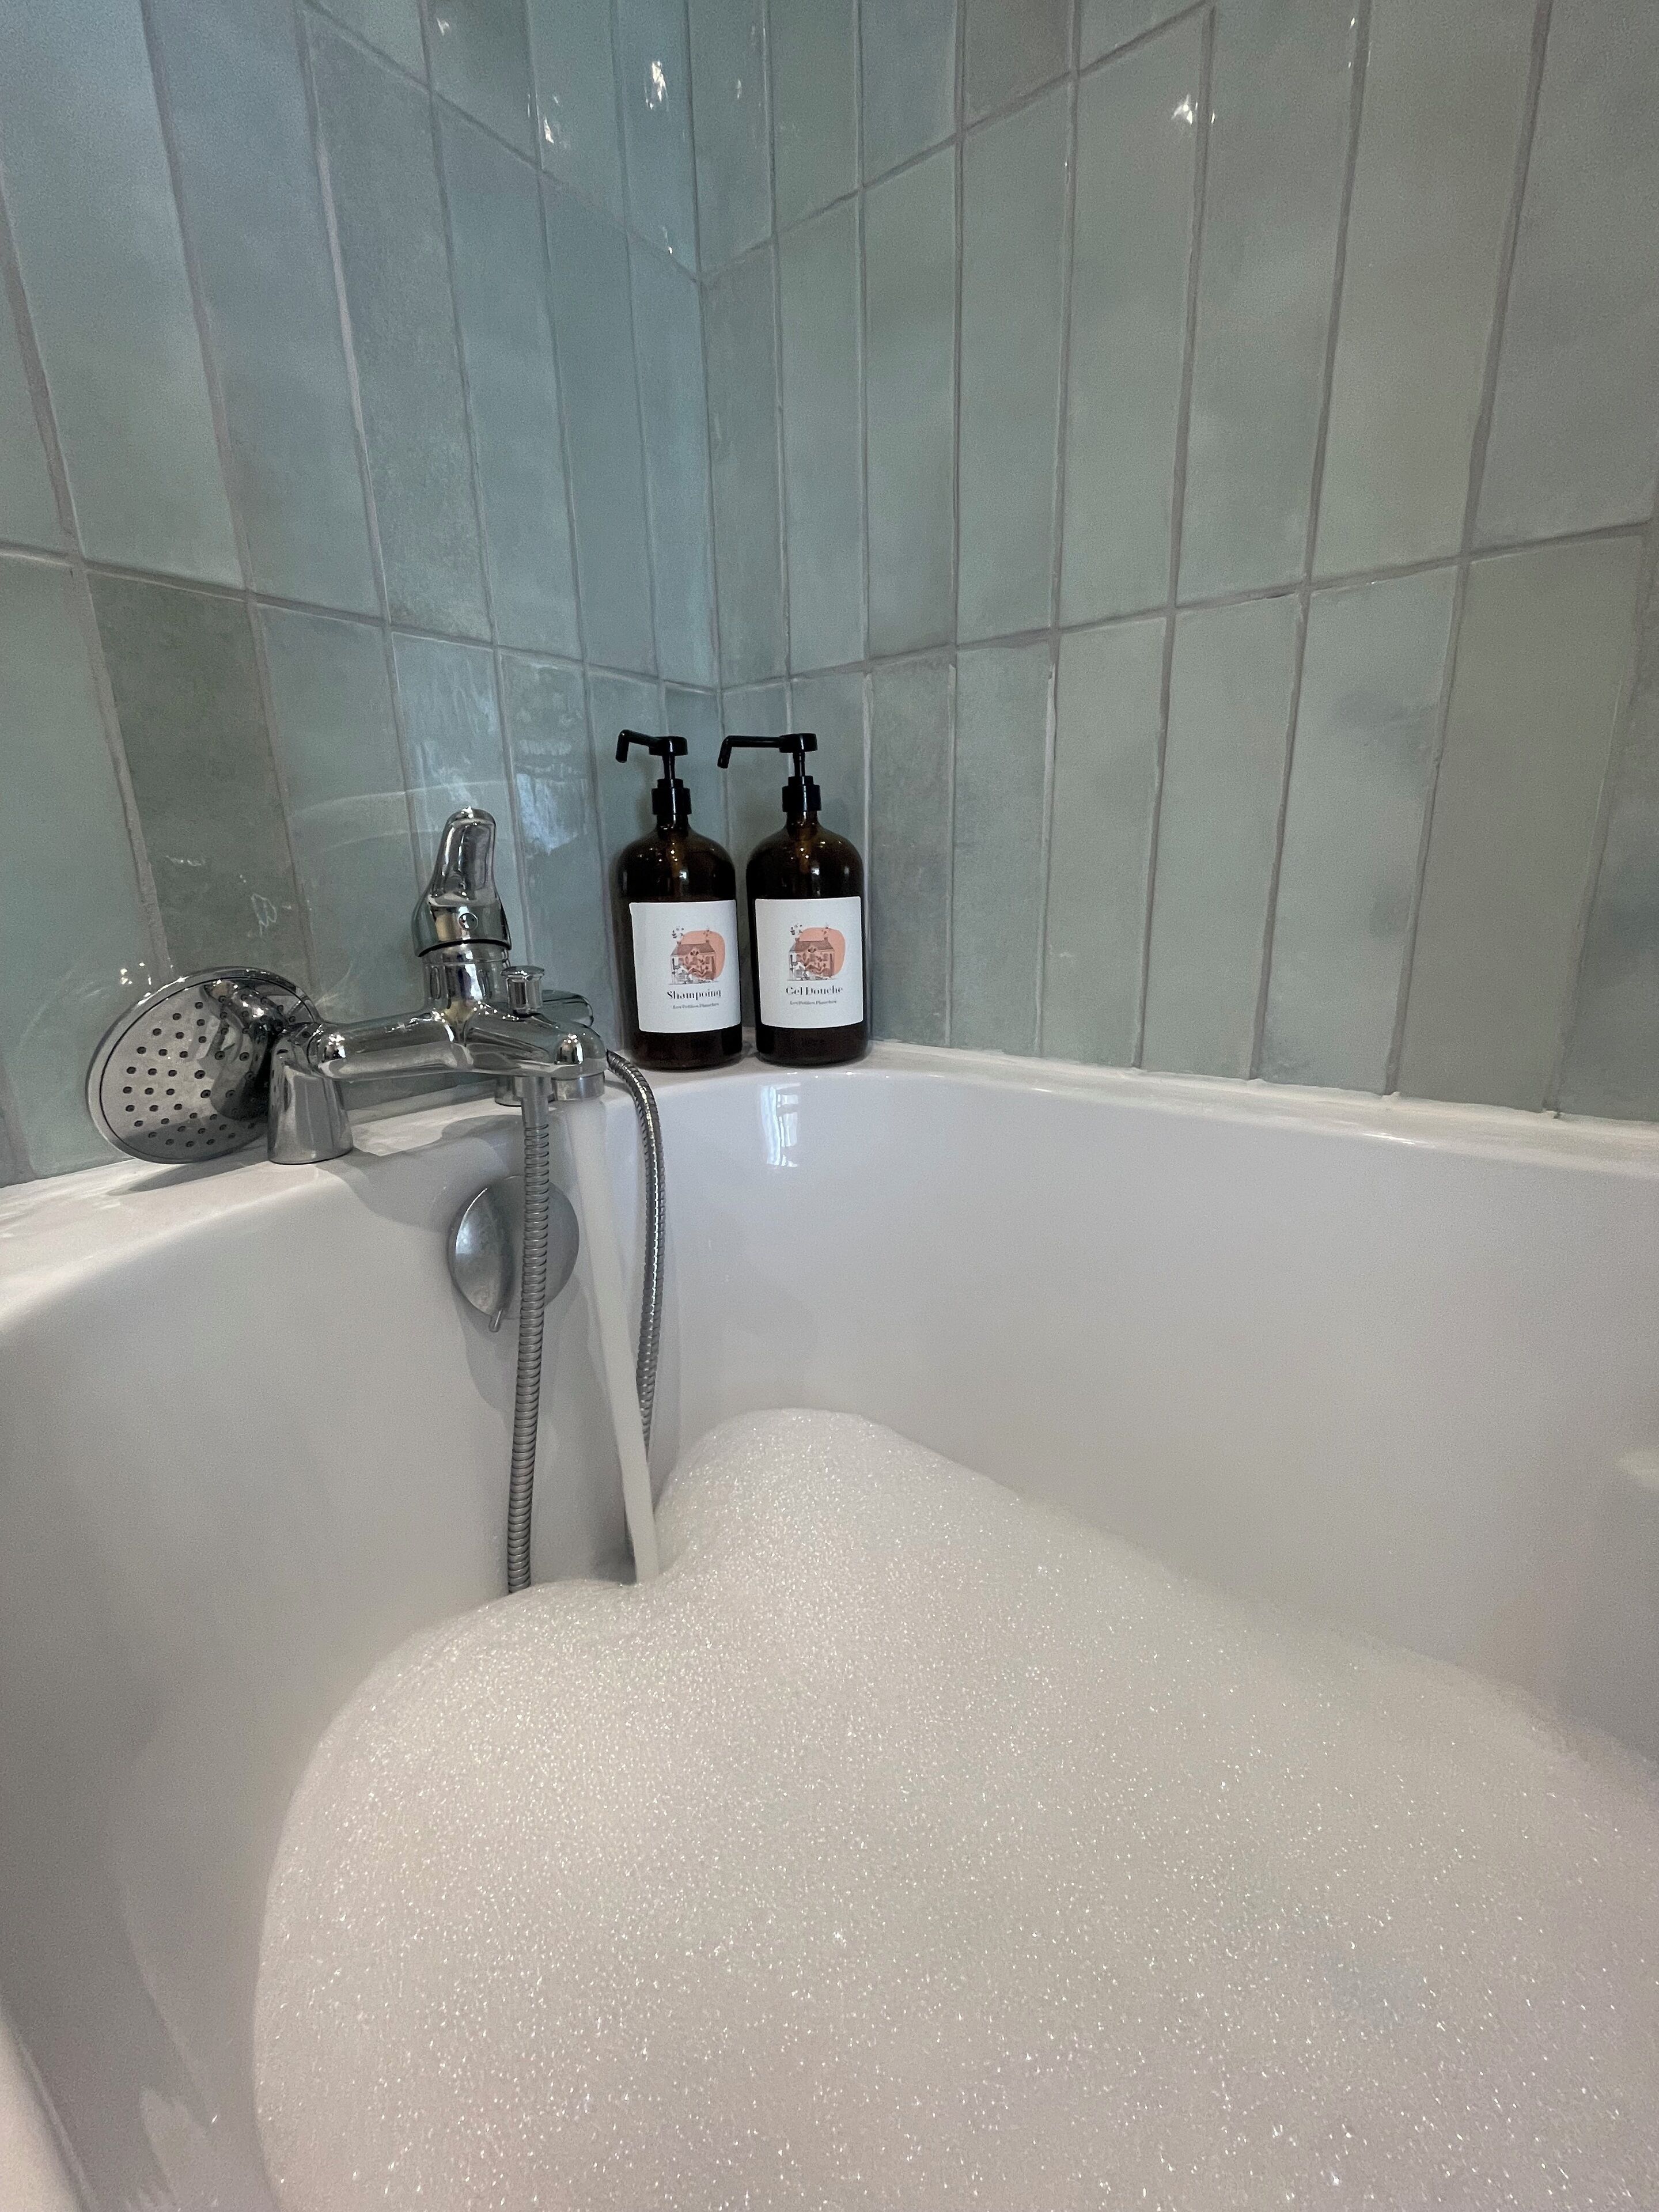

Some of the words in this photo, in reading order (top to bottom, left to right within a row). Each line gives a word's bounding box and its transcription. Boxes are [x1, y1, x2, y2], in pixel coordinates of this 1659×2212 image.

[667, 988, 721, 1001] Shampoing
[786, 986, 802, 995] Gel
[805, 985, 843, 995] Douche
